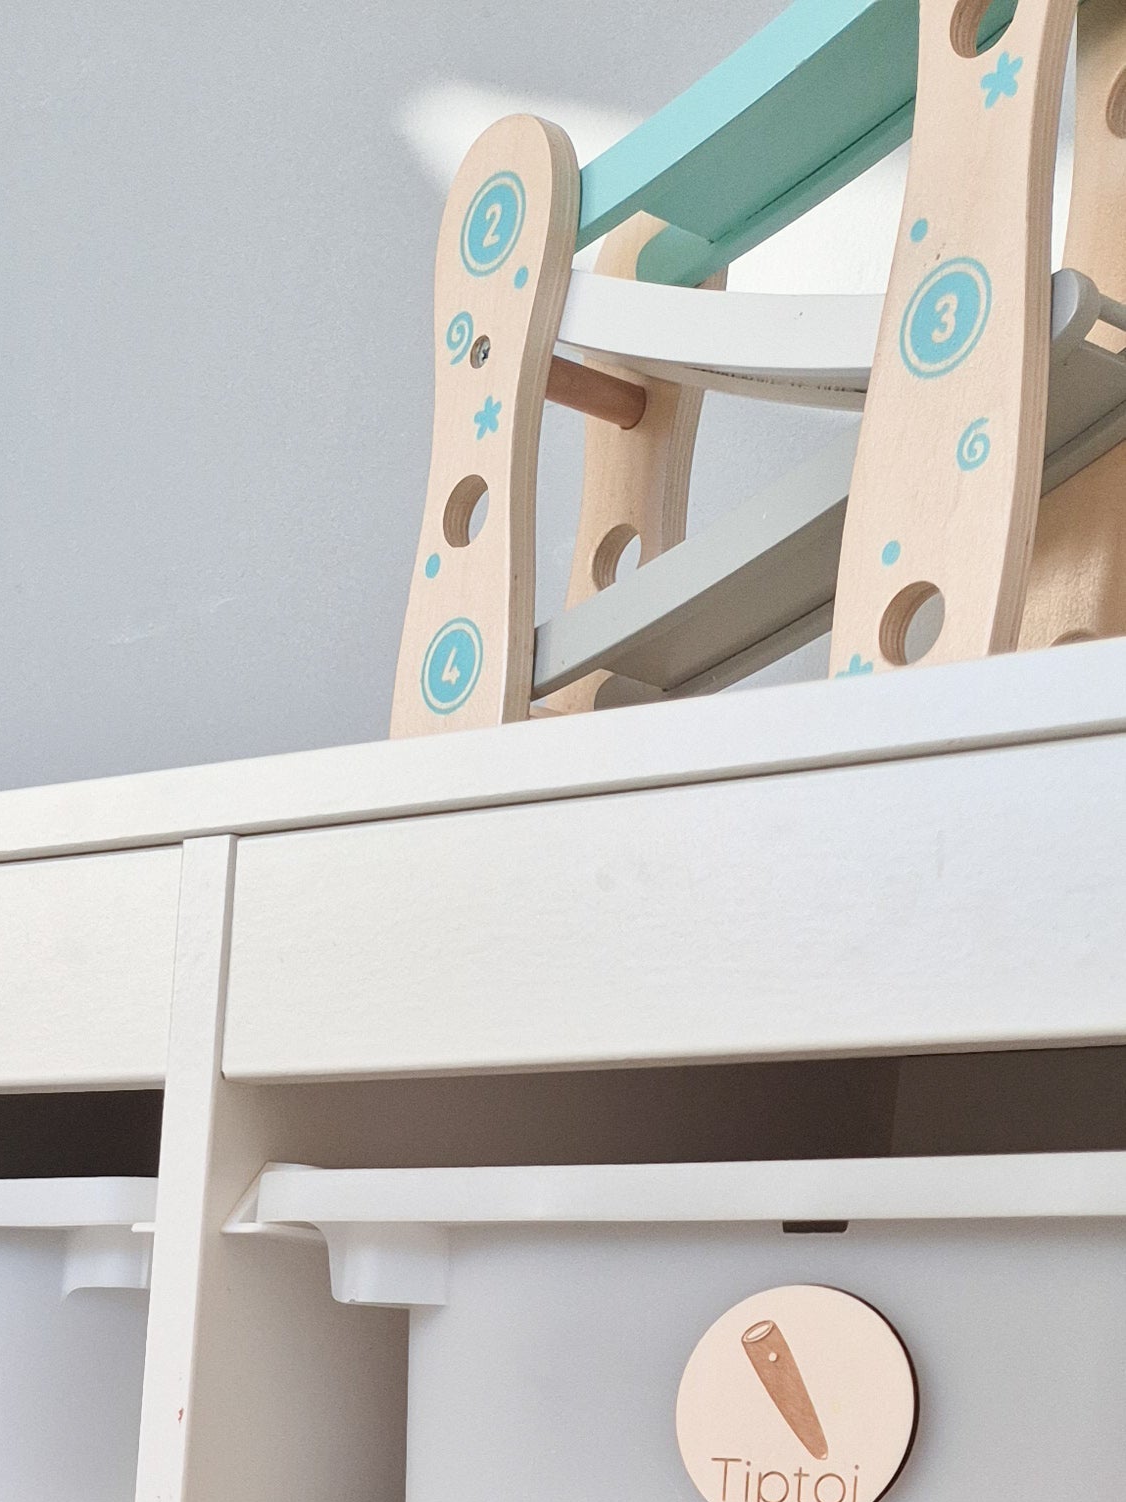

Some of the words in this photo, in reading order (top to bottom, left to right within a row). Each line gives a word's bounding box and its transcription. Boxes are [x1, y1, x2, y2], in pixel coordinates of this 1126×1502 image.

[482, 202, 502, 248] 2
[931, 292, 958, 344] 3
[441, 646, 461, 685] 4
